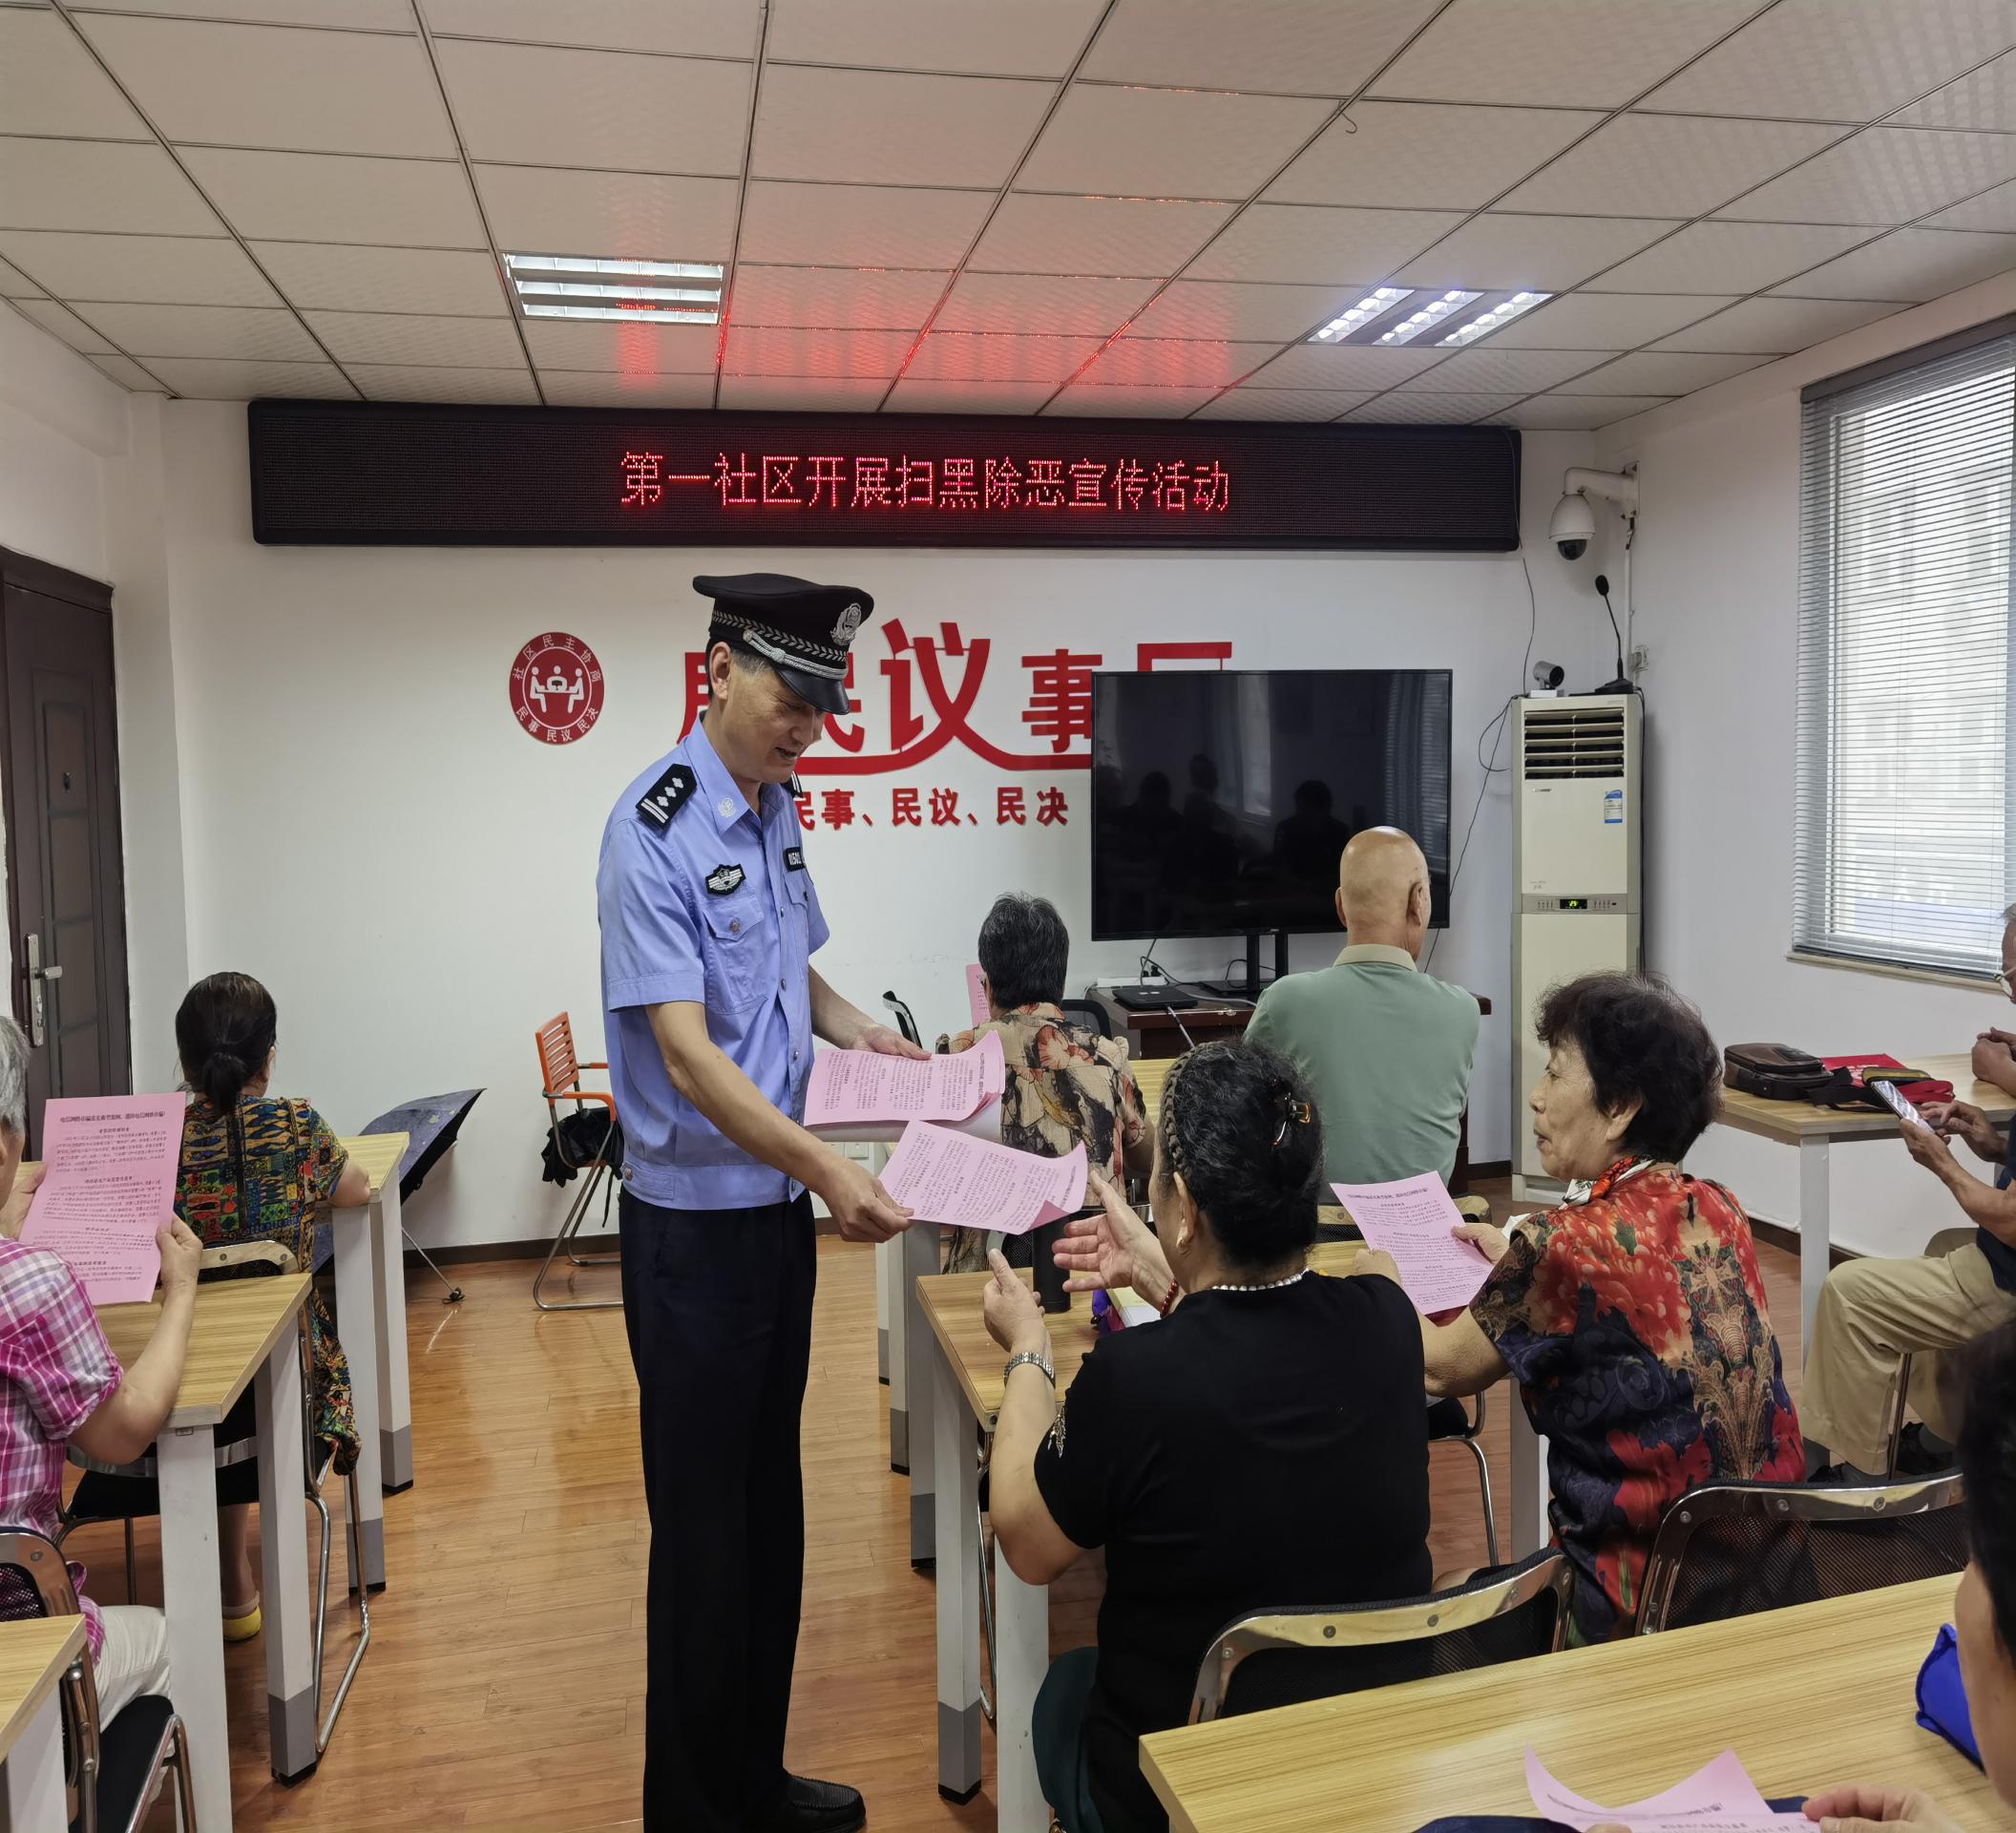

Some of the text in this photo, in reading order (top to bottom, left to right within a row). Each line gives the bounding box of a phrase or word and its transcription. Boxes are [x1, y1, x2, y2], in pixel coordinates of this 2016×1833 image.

[620, 452, 1229, 511] 第一社区开展扫黑除恶宣传活动
[513, 634, 601, 683] 社区民主协商
